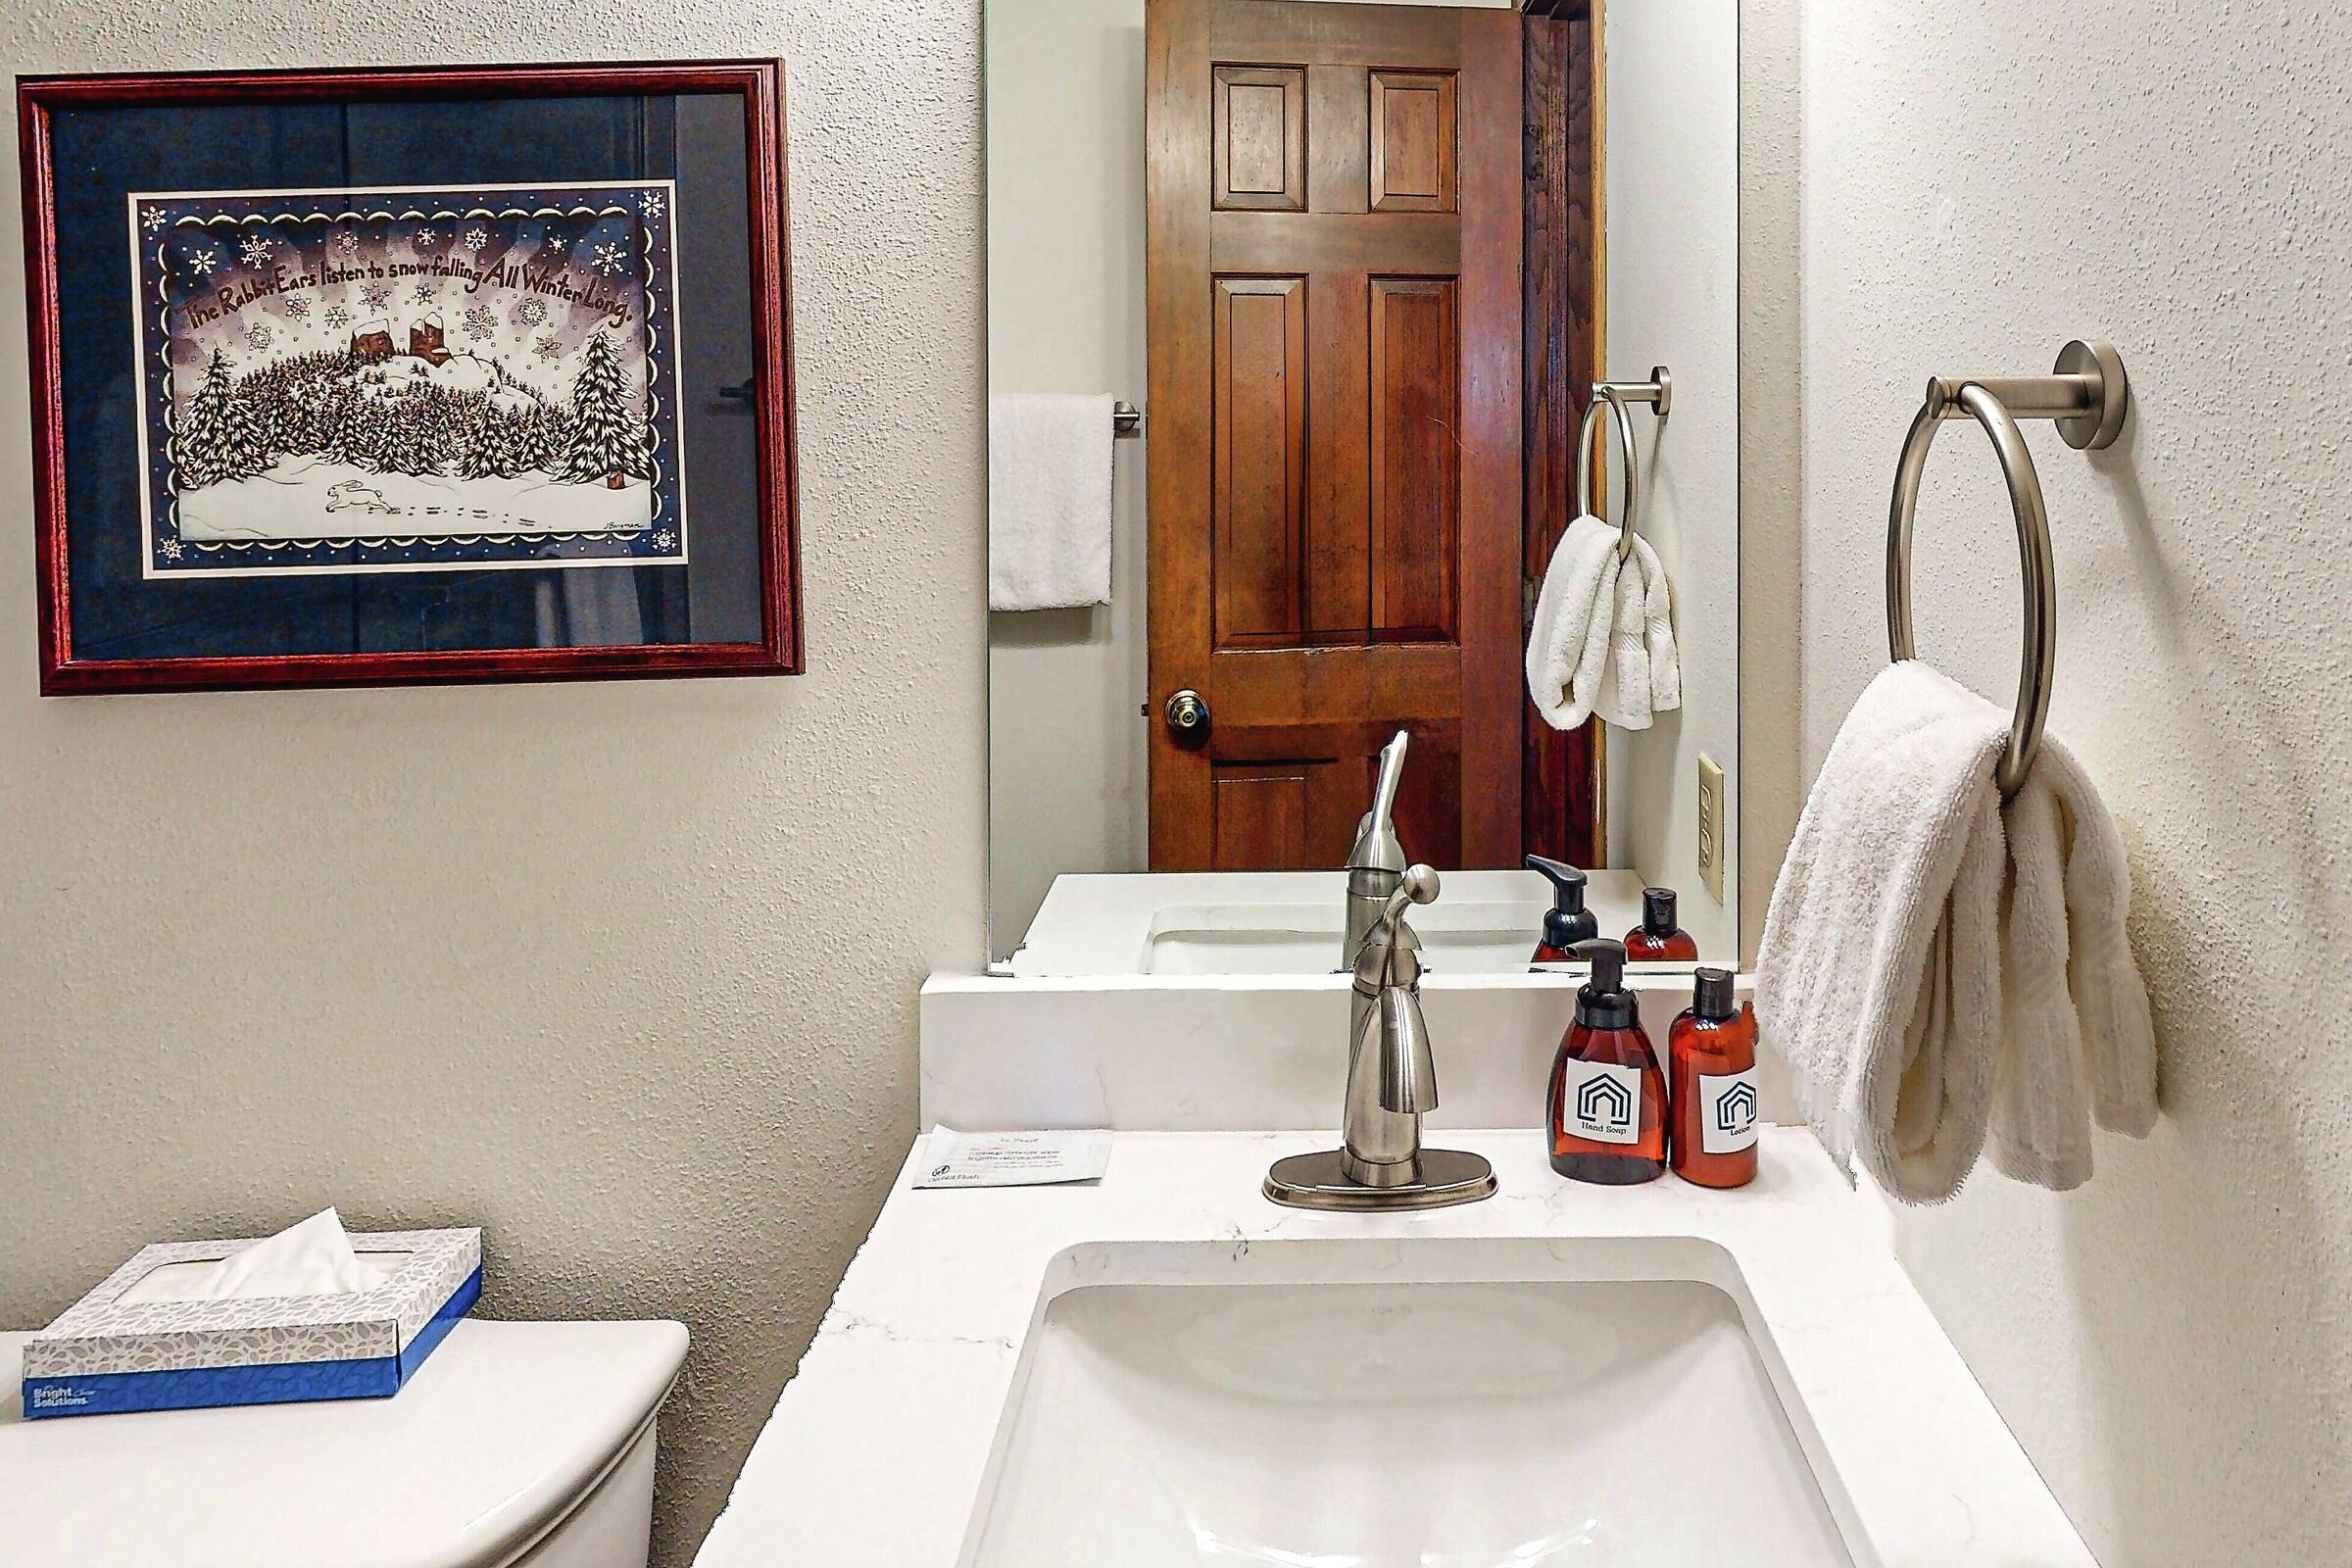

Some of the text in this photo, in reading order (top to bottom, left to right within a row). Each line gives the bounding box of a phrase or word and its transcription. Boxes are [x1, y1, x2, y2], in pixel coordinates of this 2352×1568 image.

[217, 277, 276, 317] Rabbit
[274, 264, 317, 295] Ears
[318, 259, 366, 286] listen
[368, 260, 384, 279] to
[388, 263, 429, 278] snow
[430, 255, 485, 294] falling
[481, 257, 520, 290] All
[522, 262, 584, 304] Winter
[580, 276, 634, 329] Long.
[1582, 1121, 1627, 1136] Hand Soap
[1730, 1125, 1751, 1137] Lotion
[33, 1386, 73, 1399] Bright
[33, 1396, 89, 1408] Solutions
